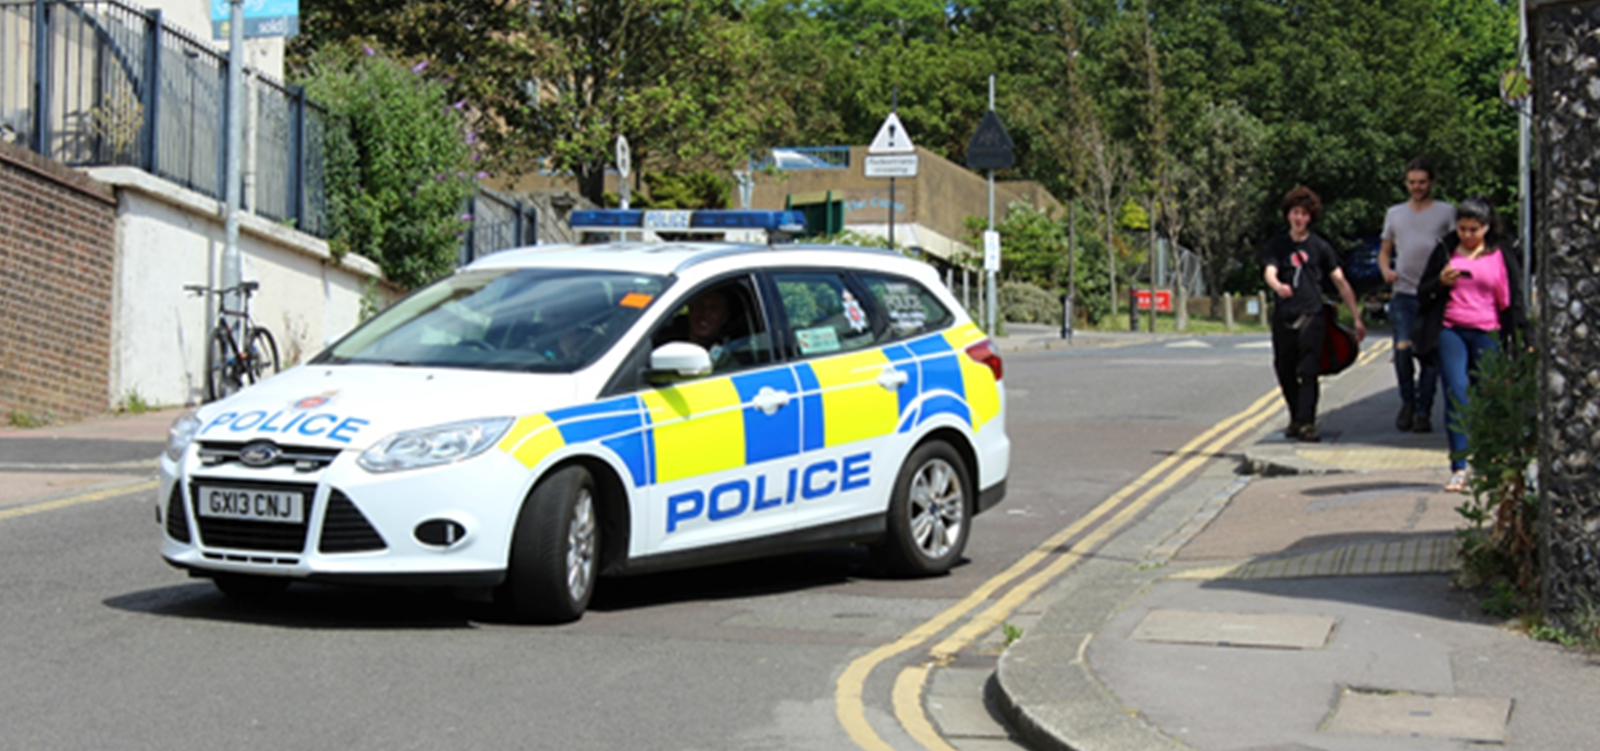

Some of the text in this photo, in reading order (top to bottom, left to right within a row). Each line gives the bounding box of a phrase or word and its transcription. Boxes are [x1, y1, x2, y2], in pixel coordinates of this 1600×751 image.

[647, 211, 688, 228] POLICE
[201, 410, 370, 443] POLICE
[209, 490, 293, 518] GX13 CNJ
[666, 451, 872, 533] POLICE
